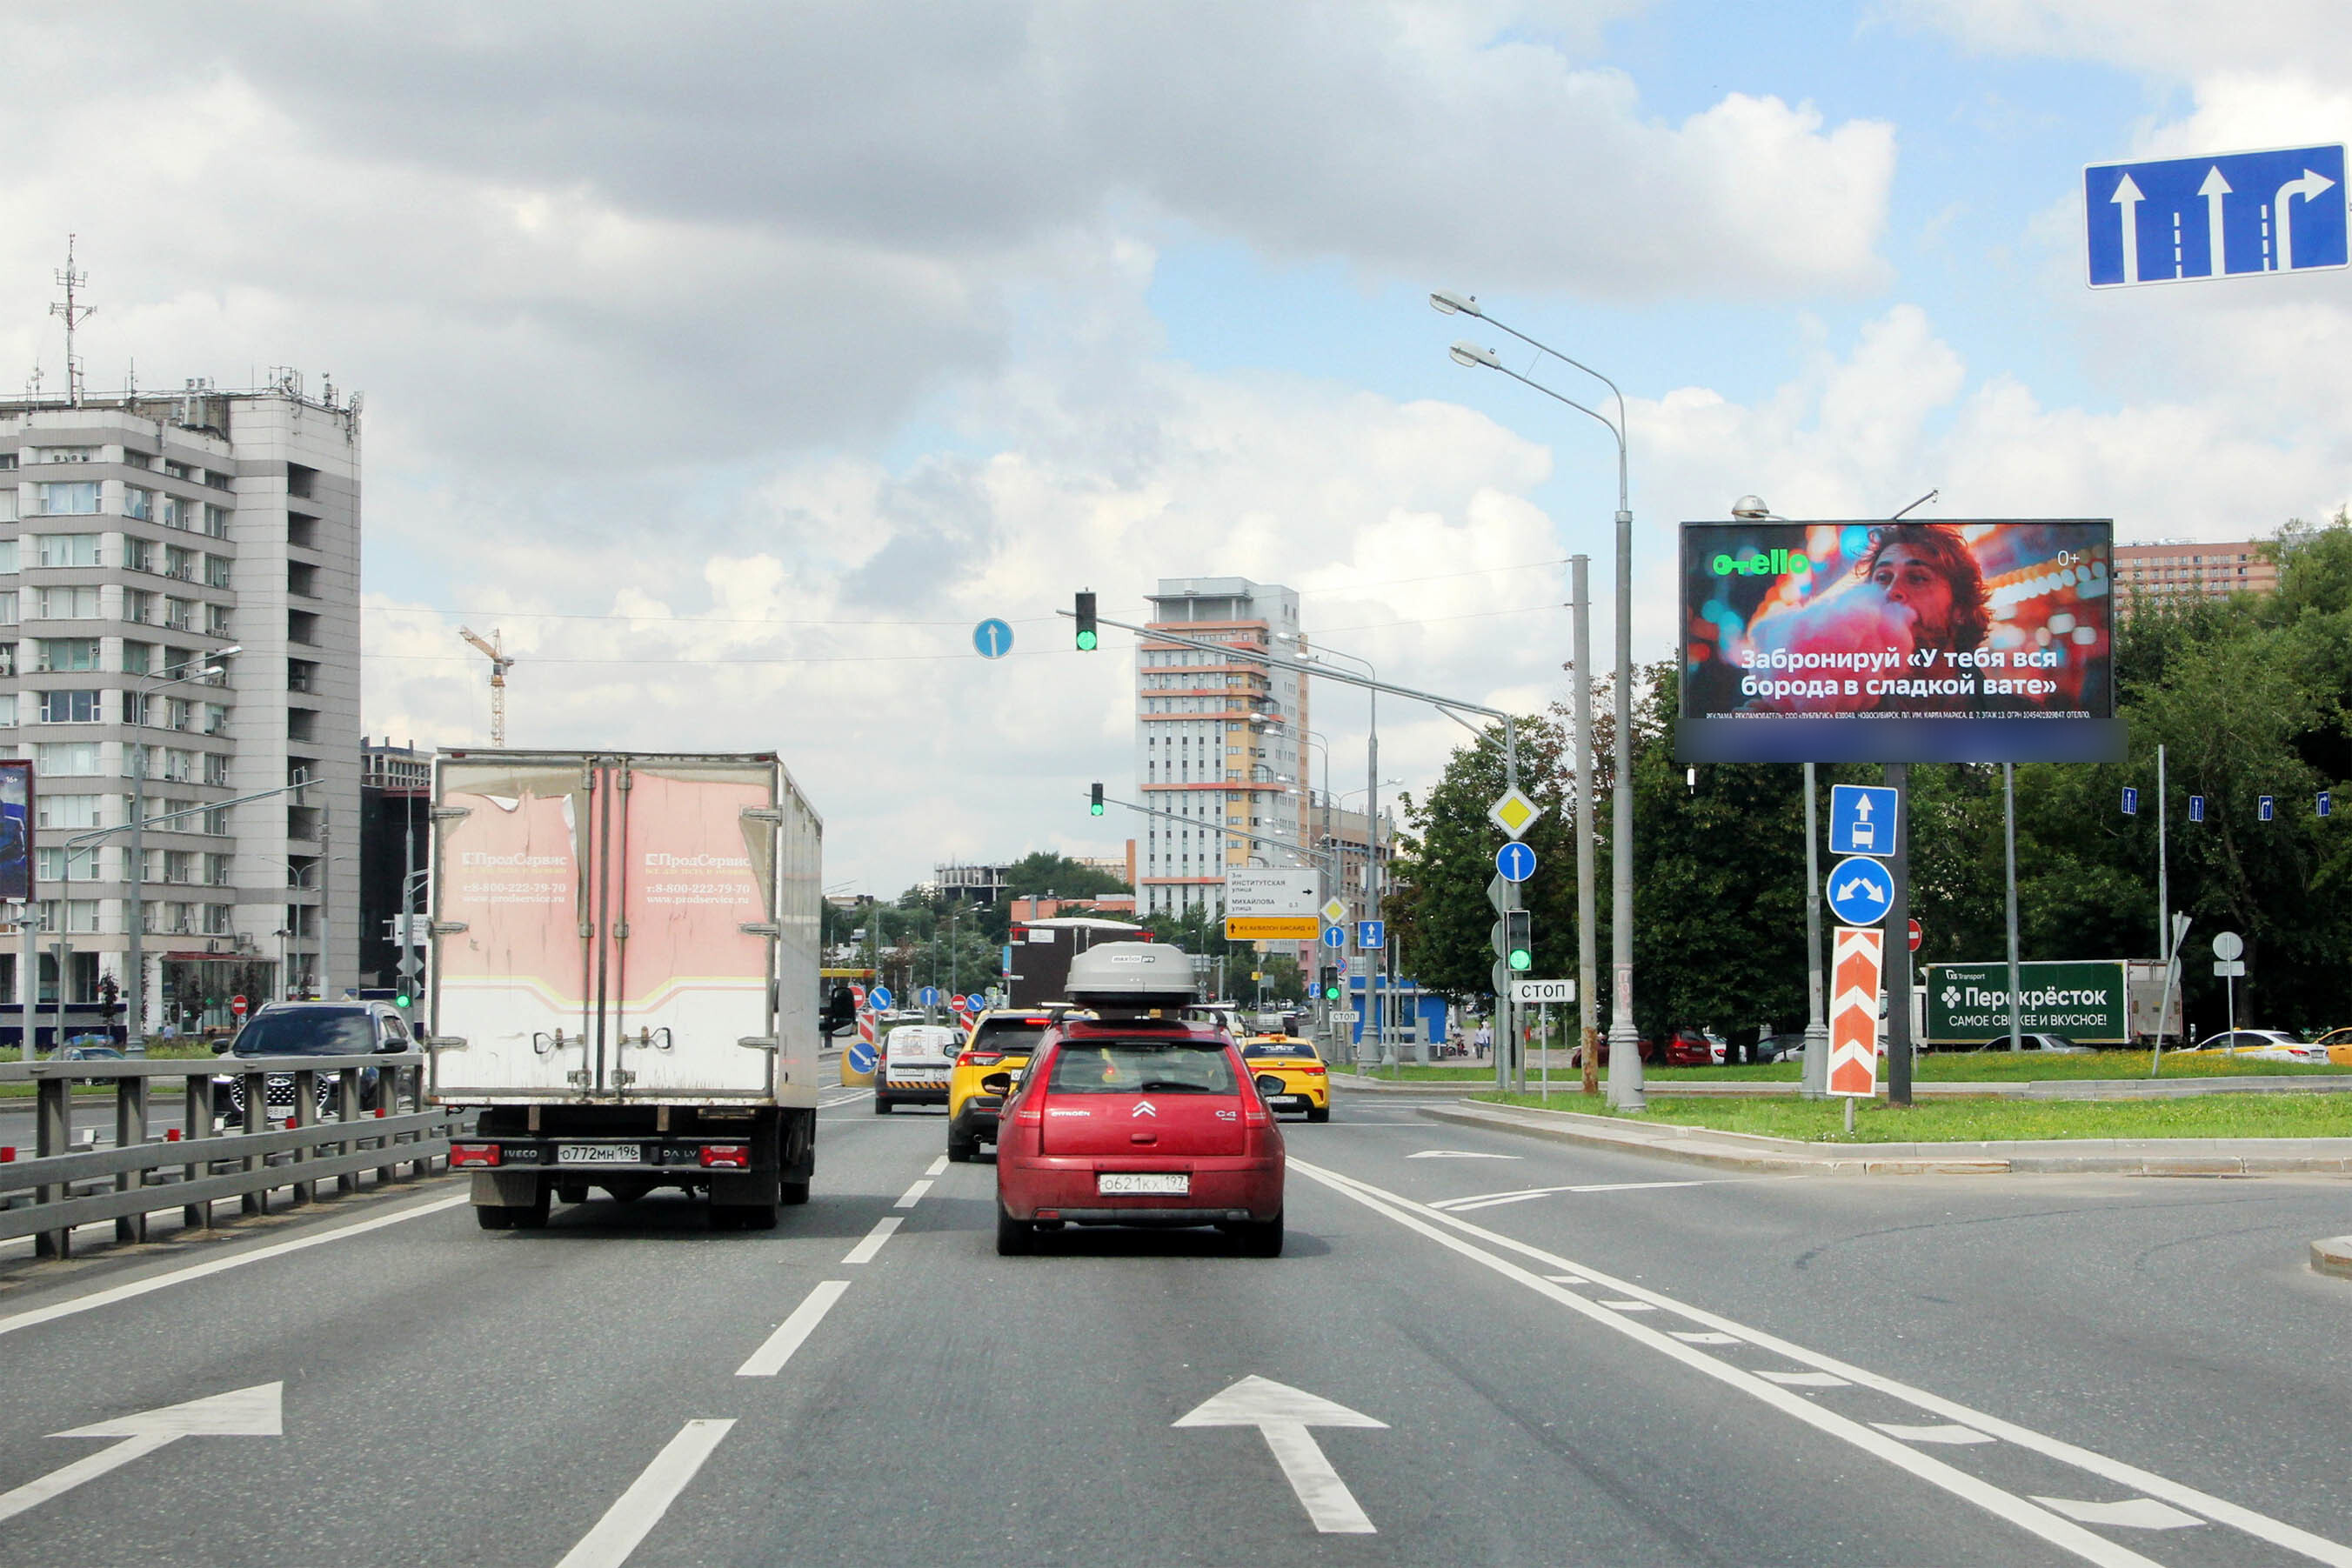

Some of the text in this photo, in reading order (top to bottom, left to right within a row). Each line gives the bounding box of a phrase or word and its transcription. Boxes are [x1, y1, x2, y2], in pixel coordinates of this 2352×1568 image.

[2058, 550, 2080, 566] 0+
[1741, 646, 2057, 672] Забронируй «У тебя вся
[1741, 673, 2057, 699] борода в сладкой вате»
[1521, 984, 1565, 998] СТОП
[1333, 1012, 1355, 1021] СТОП
[1948, 1015, 1989, 1026] САМОЕ
[2039, 1014, 2048, 1026] И
[2050, 1014, 2107, 1026] ВКУСНОЕ!
[504, 1150, 538, 1158] IVECO
